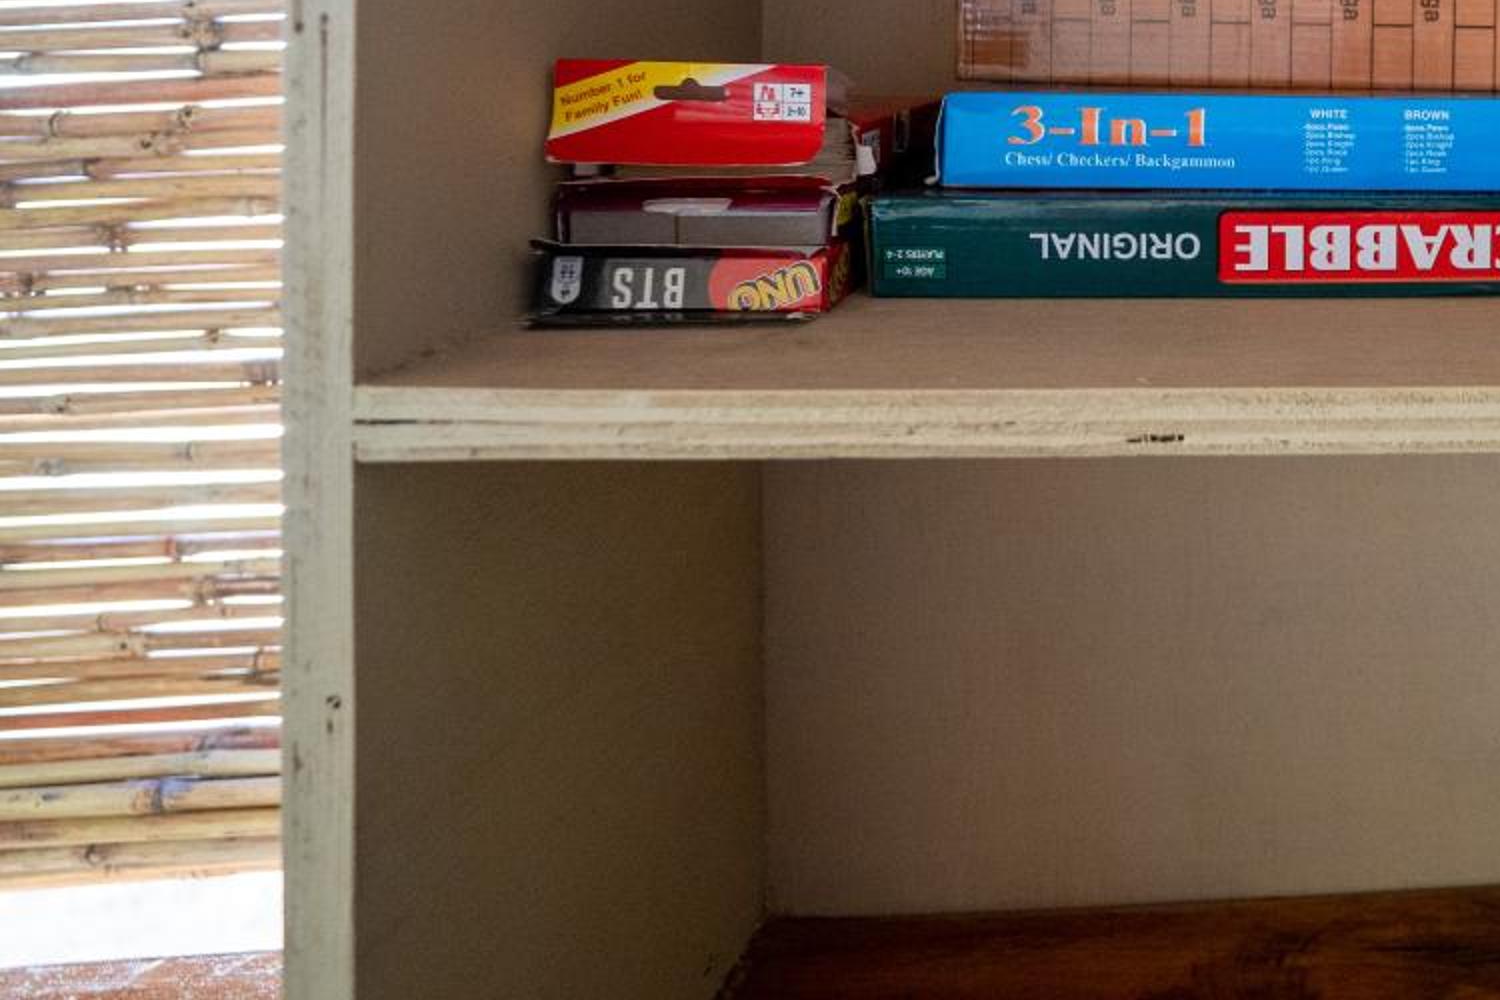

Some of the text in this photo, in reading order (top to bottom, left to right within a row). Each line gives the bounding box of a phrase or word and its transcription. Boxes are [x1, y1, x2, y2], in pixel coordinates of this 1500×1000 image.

[560, 83, 611, 105] Number
[626, 71, 646, 84] for
[789, 87, 804, 98] 7+
[564, 102, 609, 122] Family
[1310, 108, 1348, 119] WHITE
[1403, 109, 1450, 121] BROWN
[1007, 104, 1206, 147] 3-In-1
[1135, 153, 1236, 171] Backgammon
[905, 248, 945, 259] PLAYERS
[1028, 231, 1201, 260] ORIGINAL
[914, 266, 935, 278] AGE
[611, 267, 686, 309] BTS
[727, 258, 823, 311] UNO
